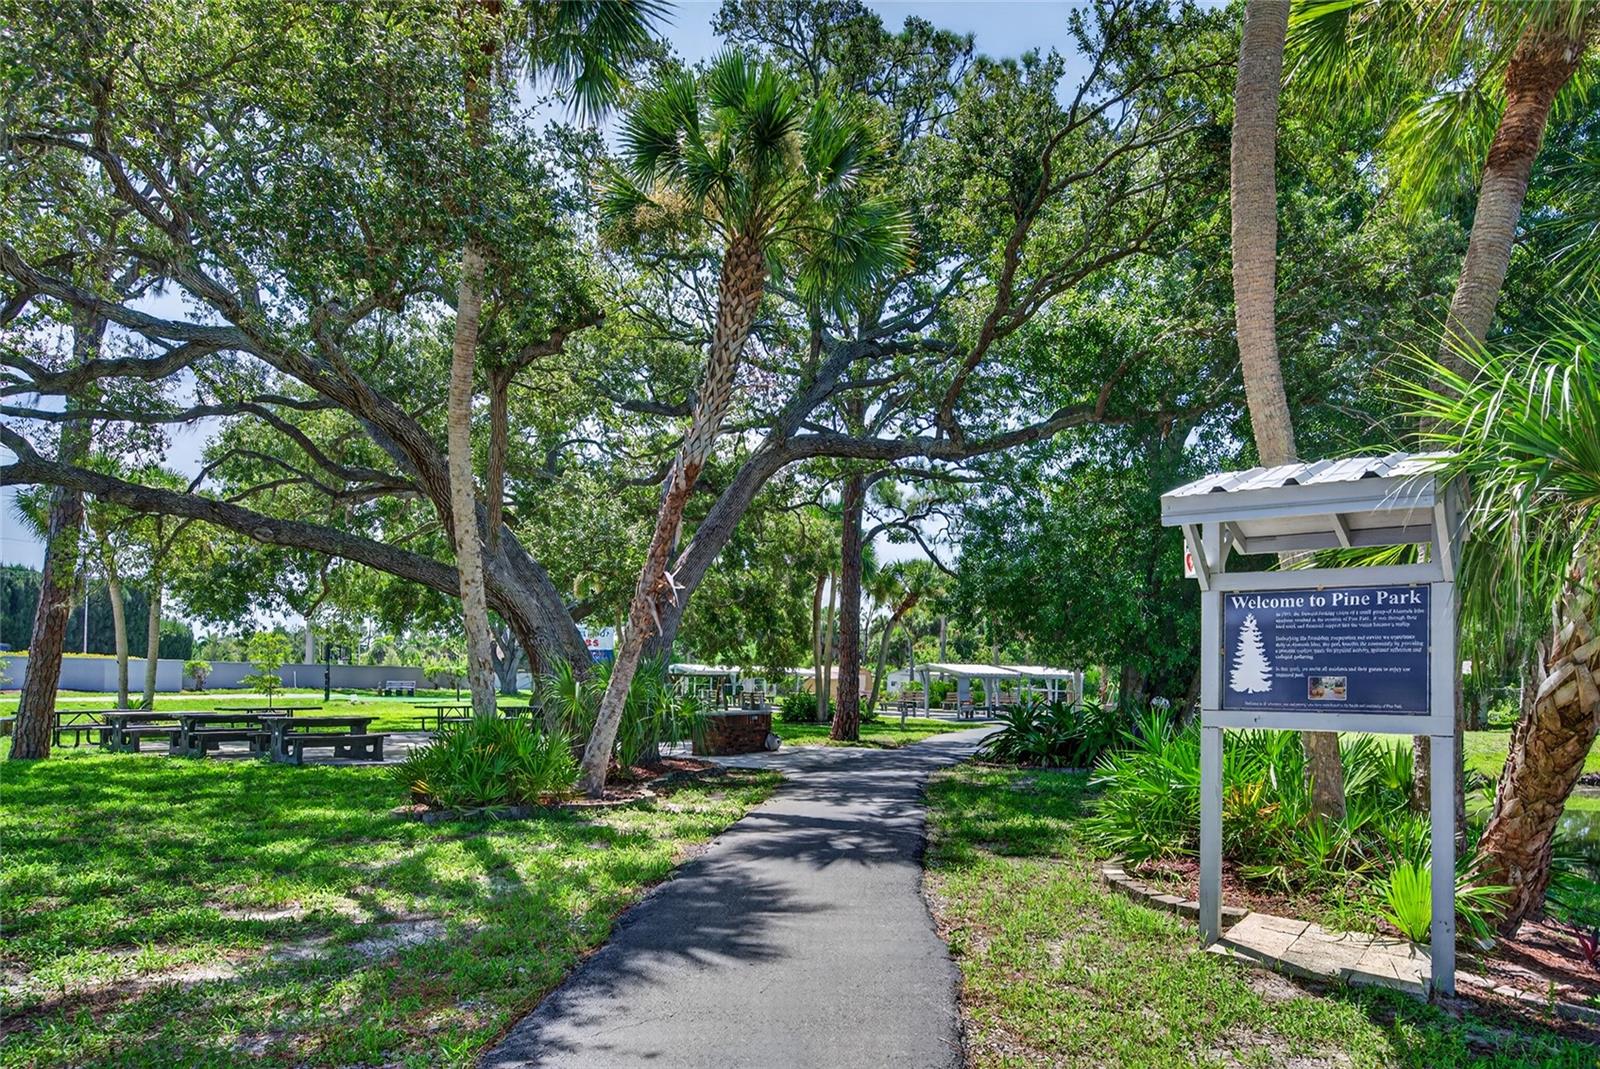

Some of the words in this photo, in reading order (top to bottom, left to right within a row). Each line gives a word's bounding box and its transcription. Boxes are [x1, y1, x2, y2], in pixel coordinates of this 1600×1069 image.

[1231, 595, 1304, 609] Welcome
[1309, 594, 1326, 607] to
[1332, 592, 1370, 607] Pine
[1376, 590, 1422, 605] Park
